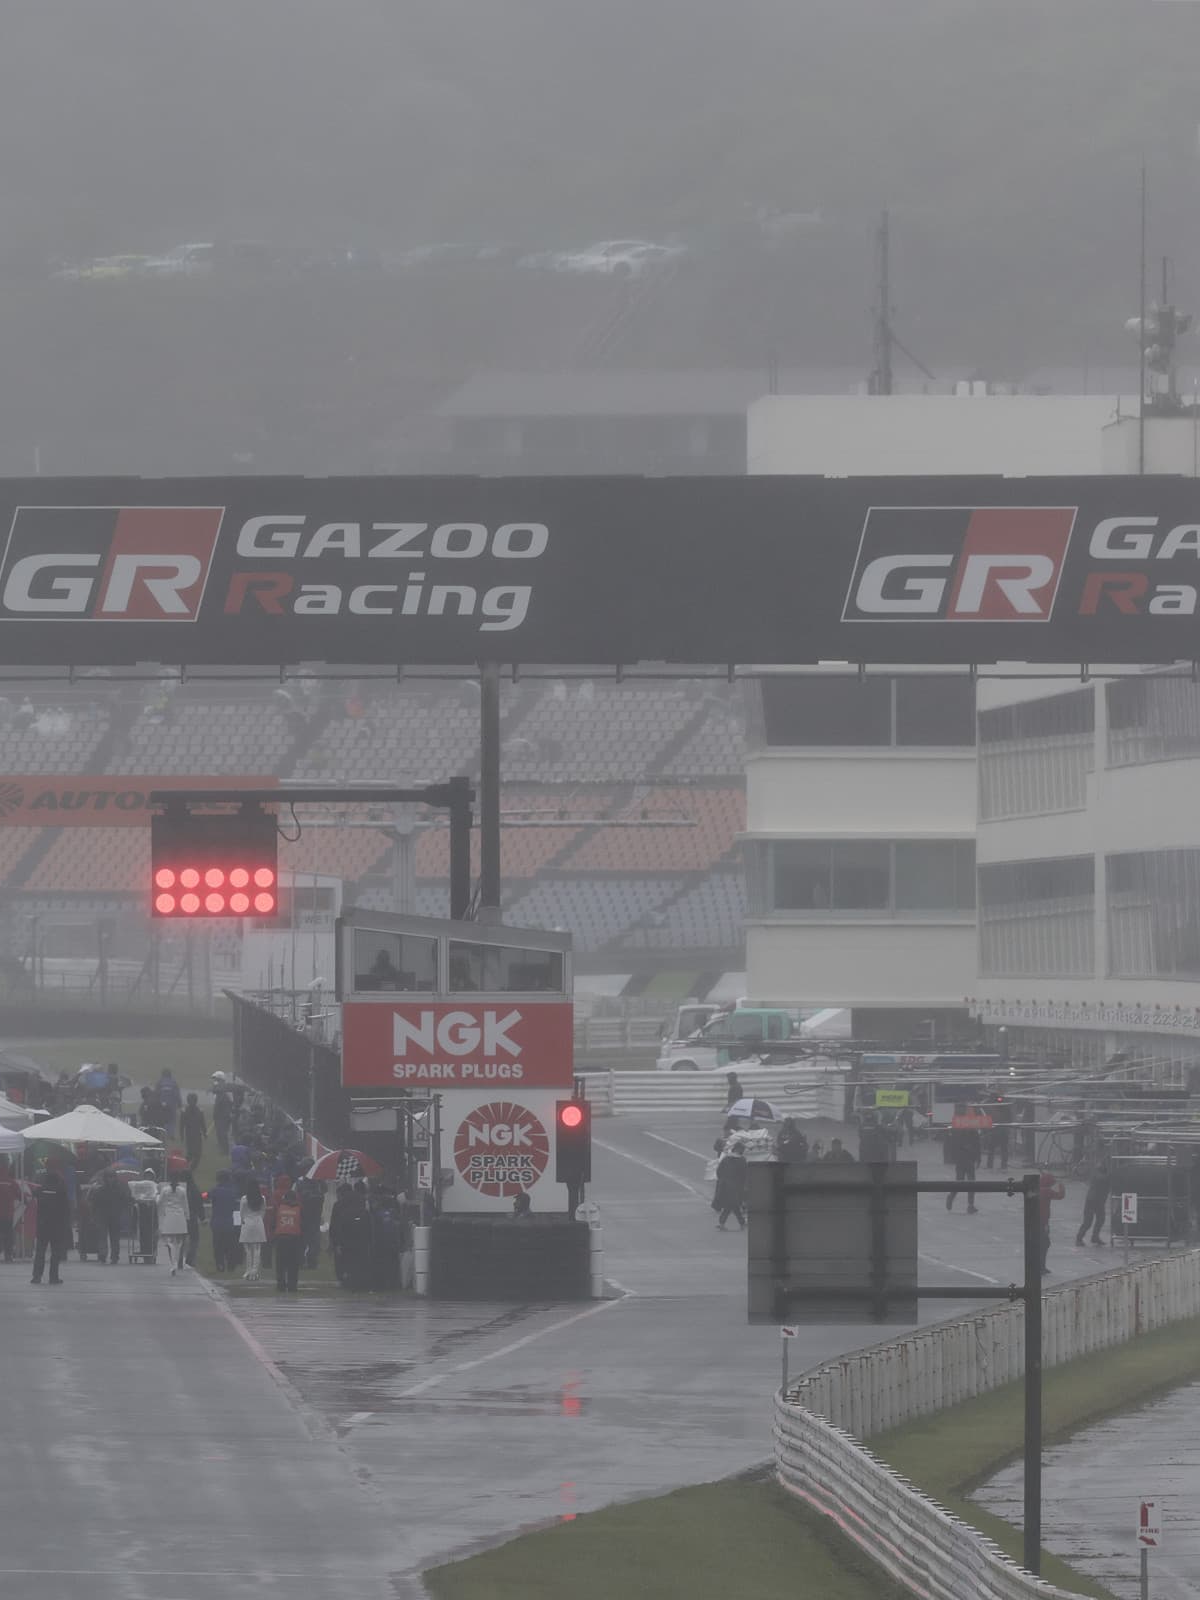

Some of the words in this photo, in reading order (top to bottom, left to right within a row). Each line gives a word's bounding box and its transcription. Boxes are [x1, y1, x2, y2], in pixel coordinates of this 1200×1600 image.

[236, 514, 550, 559] GAZOO
[2, 553, 202, 613] GR
[223, 571, 533, 632] Racing
[855, 554, 1055, 614] GR
[393, 1009, 523, 1057] NGK
[393, 1063, 455, 1079] SPARK
[461, 1063, 524, 1079] PLUGS
[468, 1123, 533, 1146] NGK
[471, 1155, 533, 1168] SPARK
[471, 1170, 533, 1183] PLUGS
